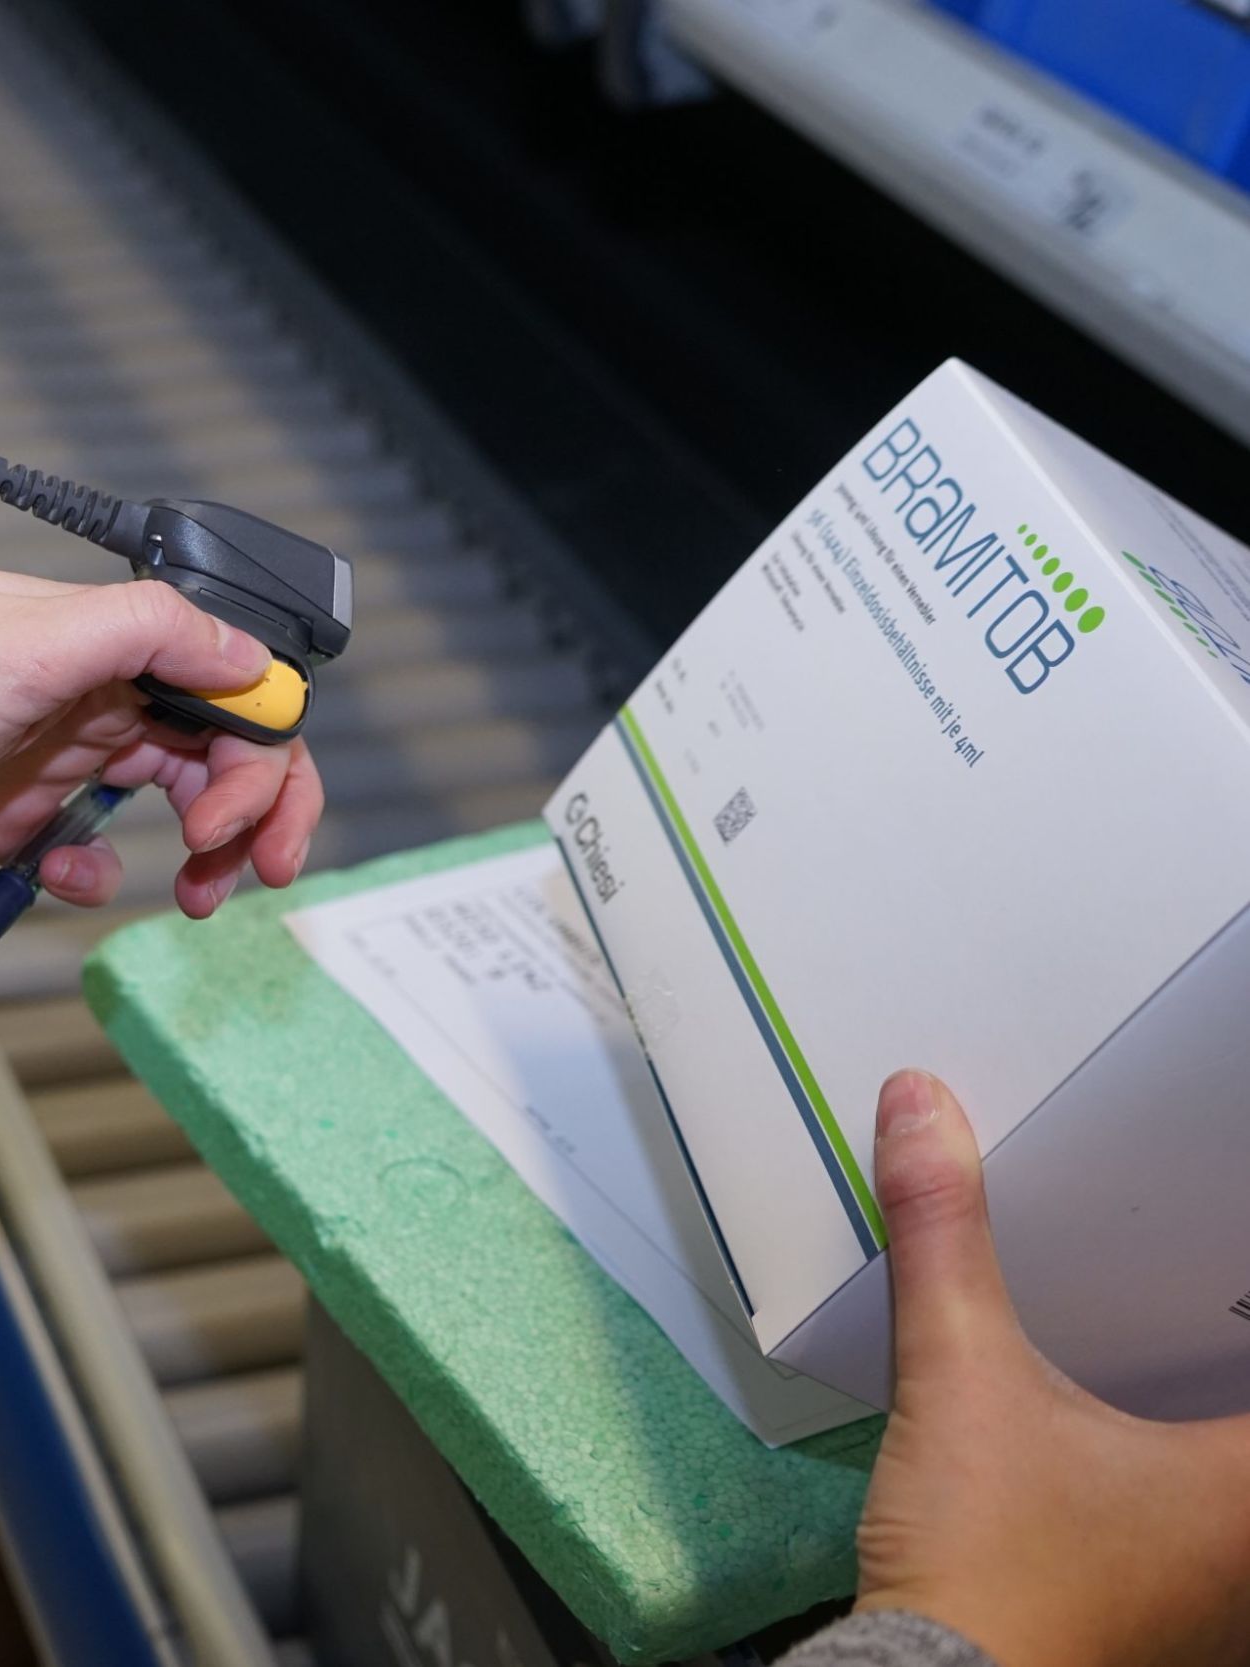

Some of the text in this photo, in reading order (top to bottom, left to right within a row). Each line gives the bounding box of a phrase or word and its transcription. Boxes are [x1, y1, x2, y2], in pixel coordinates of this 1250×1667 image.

[891, 562, 910, 587] einen
[906, 582, 936, 626] Vernebler
[841, 557, 936, 700] Einzeldosisbehältnisse
[929, 696, 955, 724] mit
[941, 714, 962, 739] je
[954, 736, 985, 768] 4ml
[574, 816, 626, 905] Chiesi
